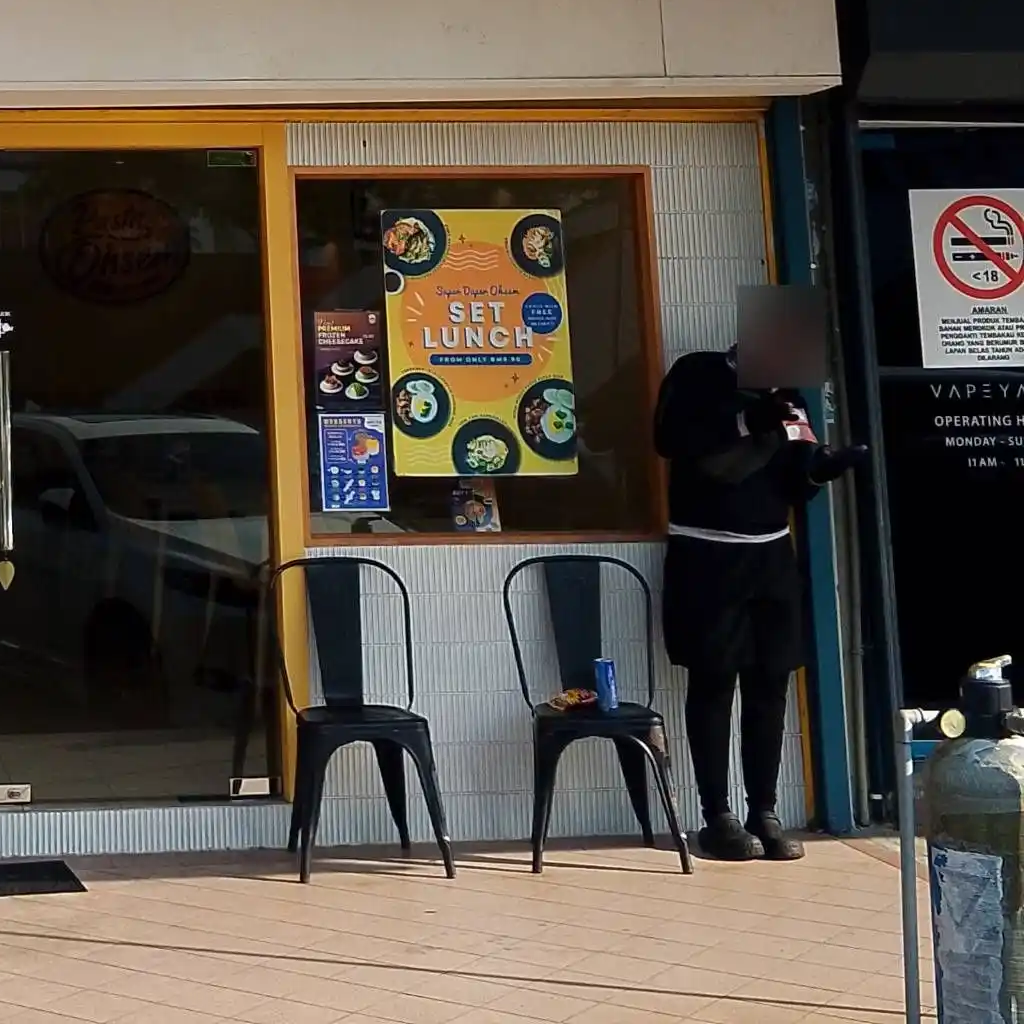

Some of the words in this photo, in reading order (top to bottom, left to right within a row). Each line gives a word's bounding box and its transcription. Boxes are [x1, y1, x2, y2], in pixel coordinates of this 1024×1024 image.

[448, 301, 506, 324] SET
[971, 306, 1008, 315] AMARAN
[423, 326, 534, 349] LUNCH
[934, 415, 1013, 427] OPERATING
[945, 436, 996, 447] MONDAY
